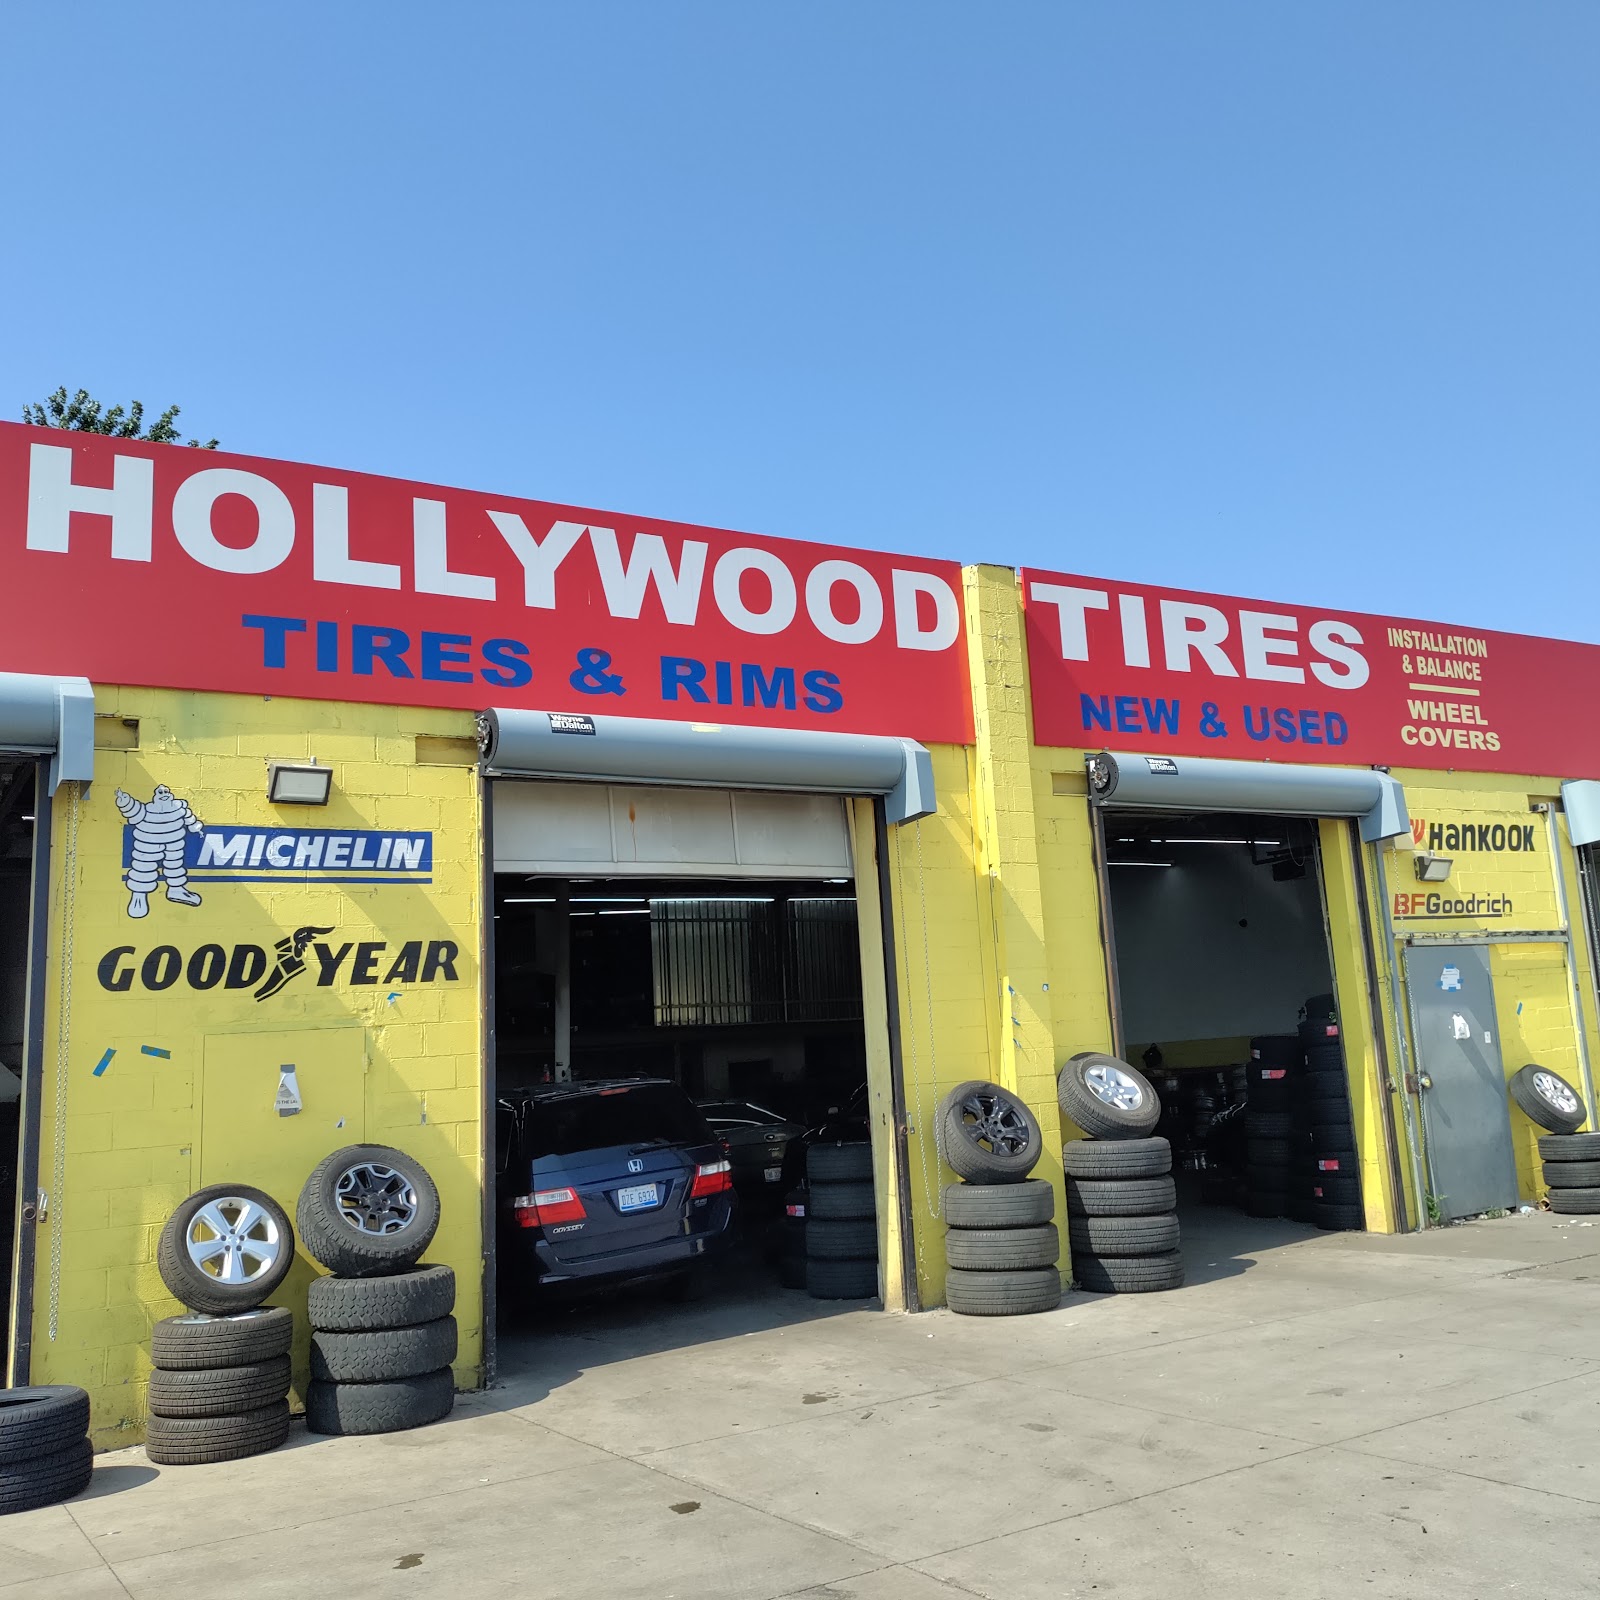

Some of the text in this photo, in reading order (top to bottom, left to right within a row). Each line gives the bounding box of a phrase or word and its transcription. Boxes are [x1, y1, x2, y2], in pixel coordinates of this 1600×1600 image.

[26, 443, 960, 652] HOLLYWOOD
[1030, 582, 1370, 690] TIRES
[1387, 628, 1488, 658] INSTALLATION
[242, 614, 844, 714] TIRES & RIMS
[1402, 654, 1482, 682] & BALANCE
[550, 714, 584, 722] Wayne
[562, 721, 592, 730] Dalton
[1080, 693, 1349, 746] NEW & USED
[1407, 699, 1489, 726] WHEEL
[1401, 725, 1501, 752] COVERS
[197, 833, 426, 869] MICHELIN
[1394, 893, 1513, 915] BFGoodrich
[552, 1223, 585, 1234] ODYSSEY
